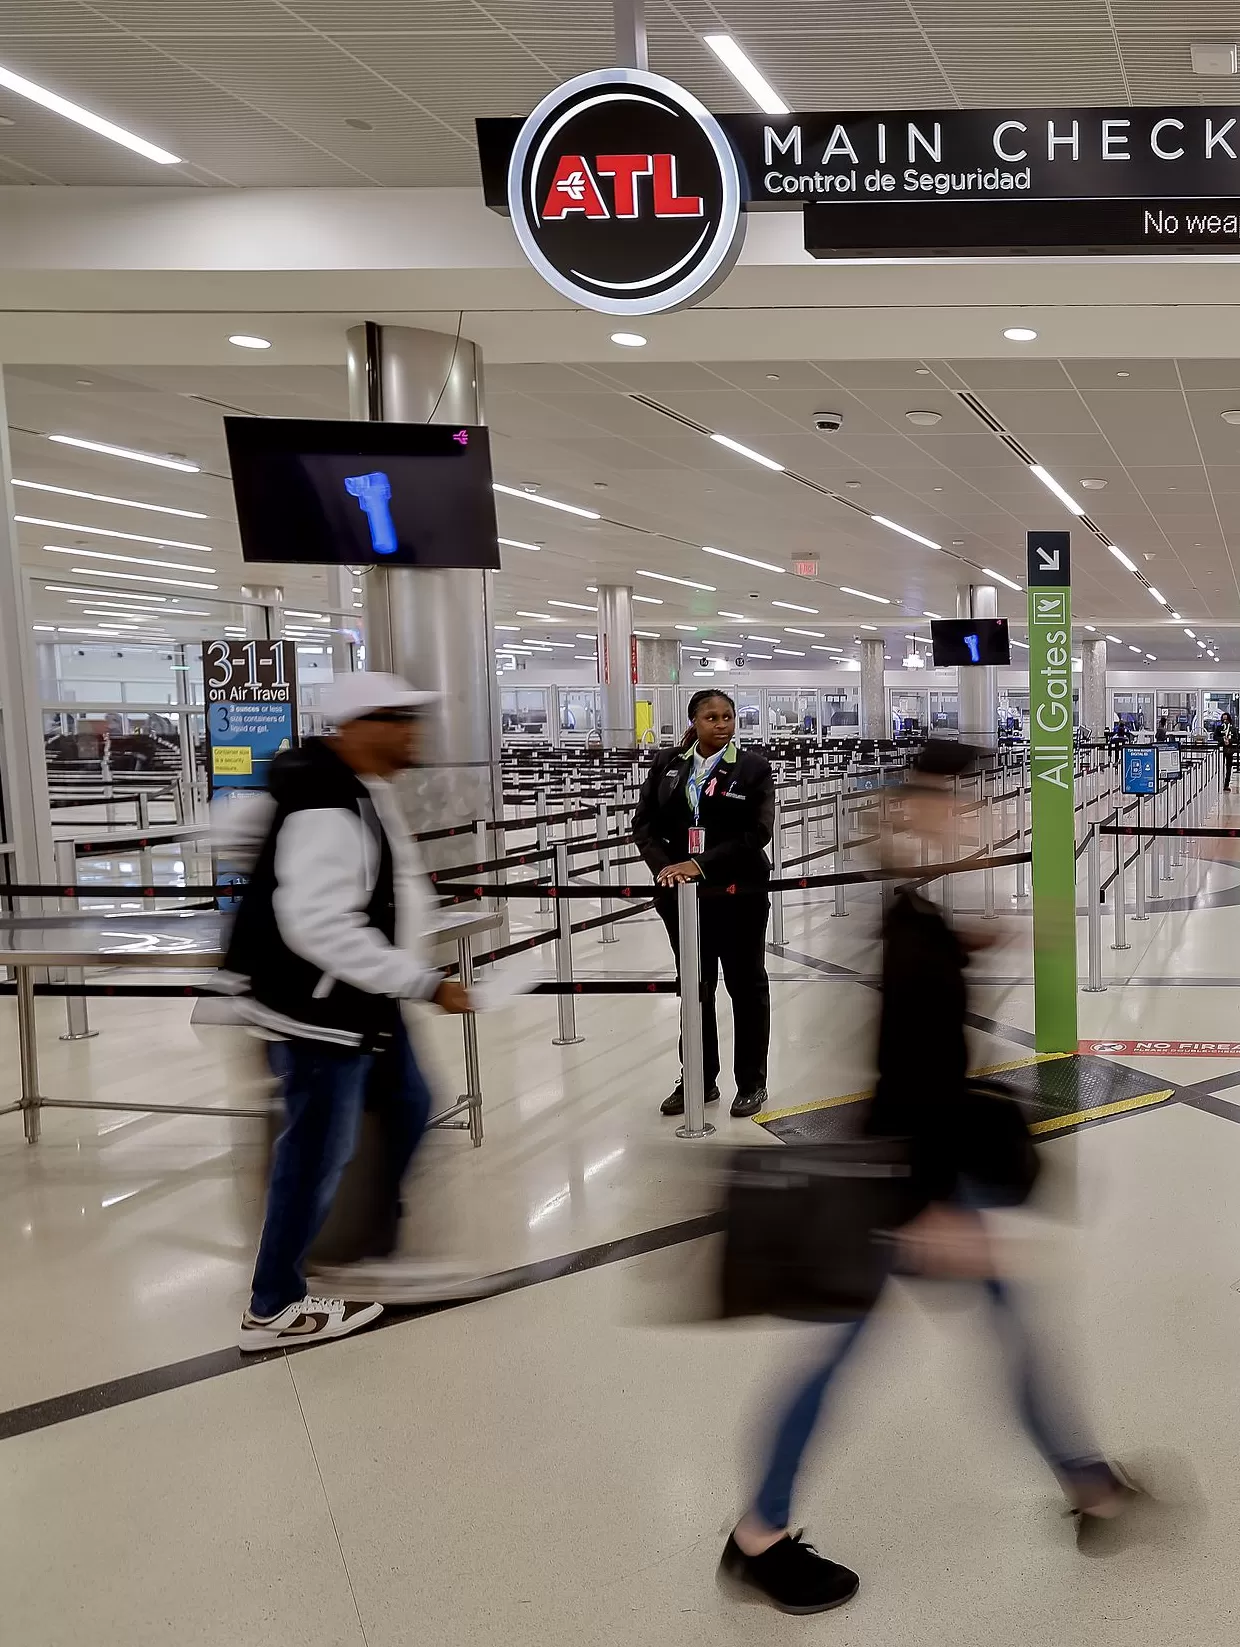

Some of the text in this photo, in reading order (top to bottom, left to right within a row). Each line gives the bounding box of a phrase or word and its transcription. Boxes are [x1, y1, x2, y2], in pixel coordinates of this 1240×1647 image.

[763, 122, 943, 166] MAIN
[541, 153, 704, 220] ATL
[763, 167, 1032, 194] Control de Seguridad
[1144, 209, 1179, 234] No
[207, 640, 290, 688] 3-1-1
[209, 686, 290, 701] on Air Travel
[1034, 630, 1069, 789] All Gates
[217, 706, 230, 732] 3
